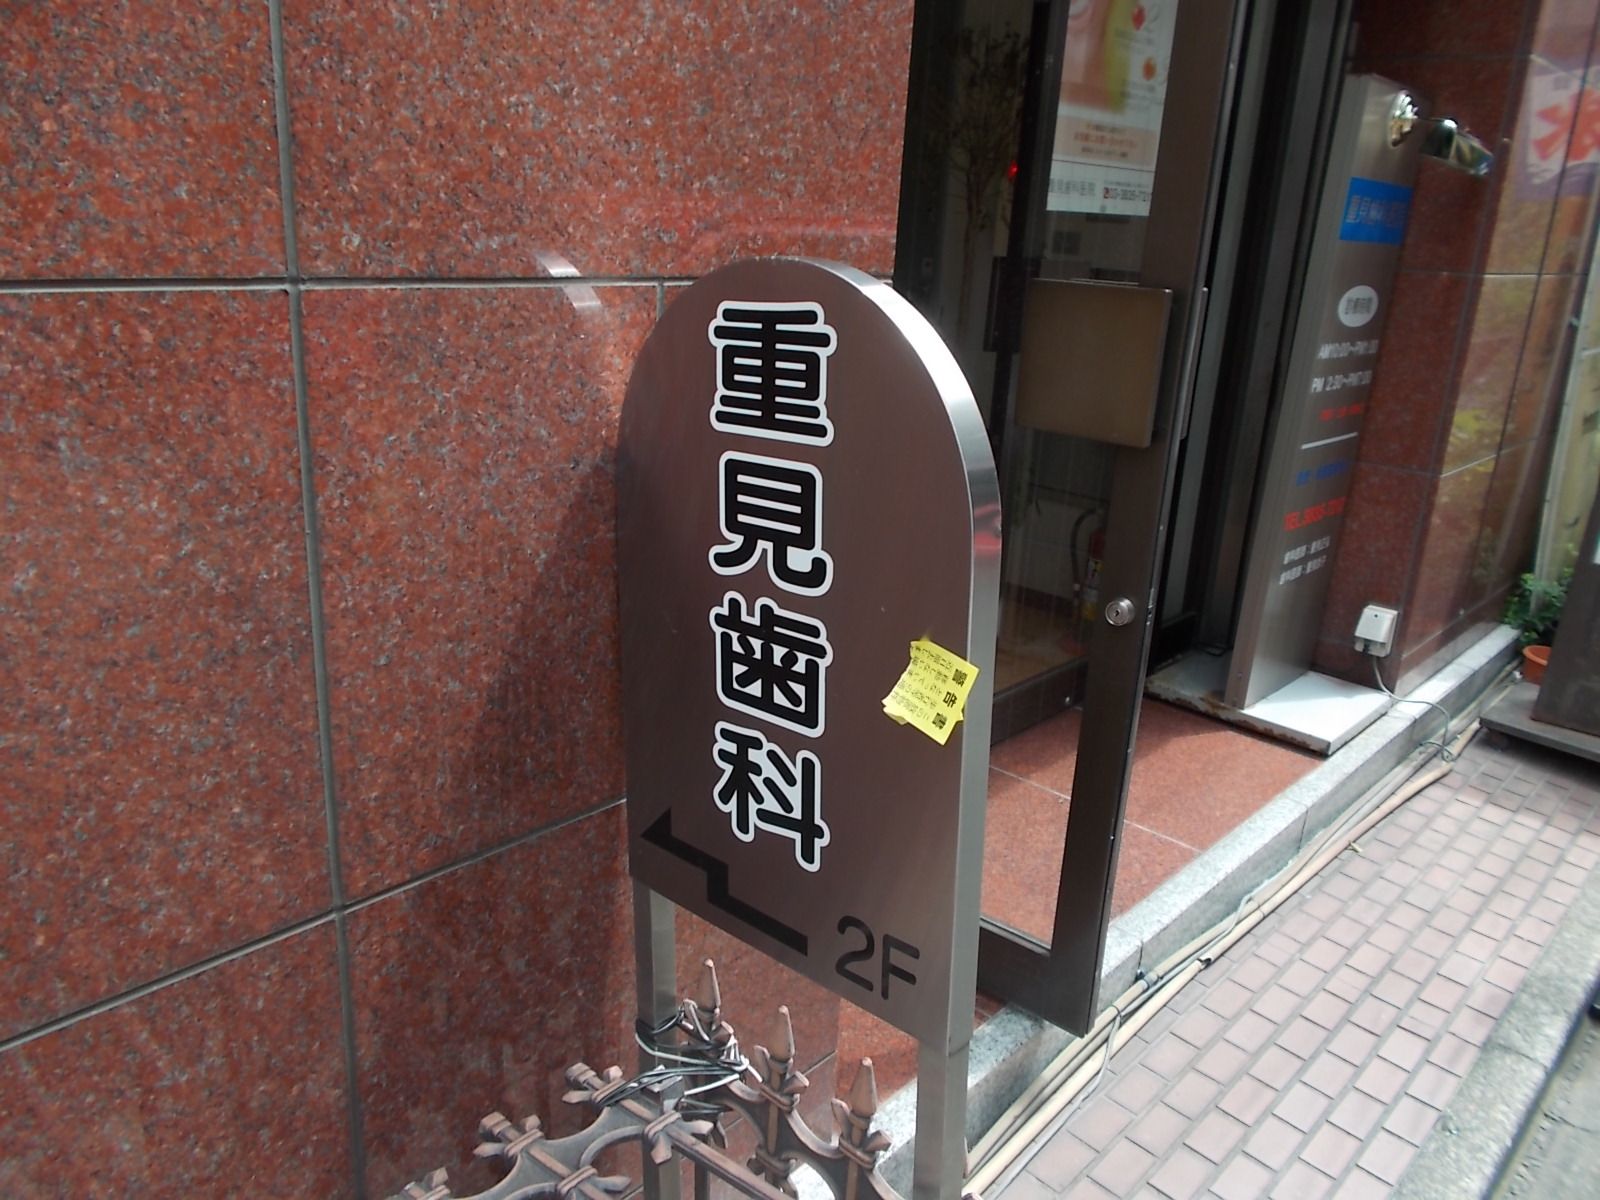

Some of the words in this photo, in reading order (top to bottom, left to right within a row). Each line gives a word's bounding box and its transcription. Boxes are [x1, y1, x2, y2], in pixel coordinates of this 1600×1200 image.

[708, 300, 837, 872] 重見歯科
[838, 915, 921, 999] 2F
